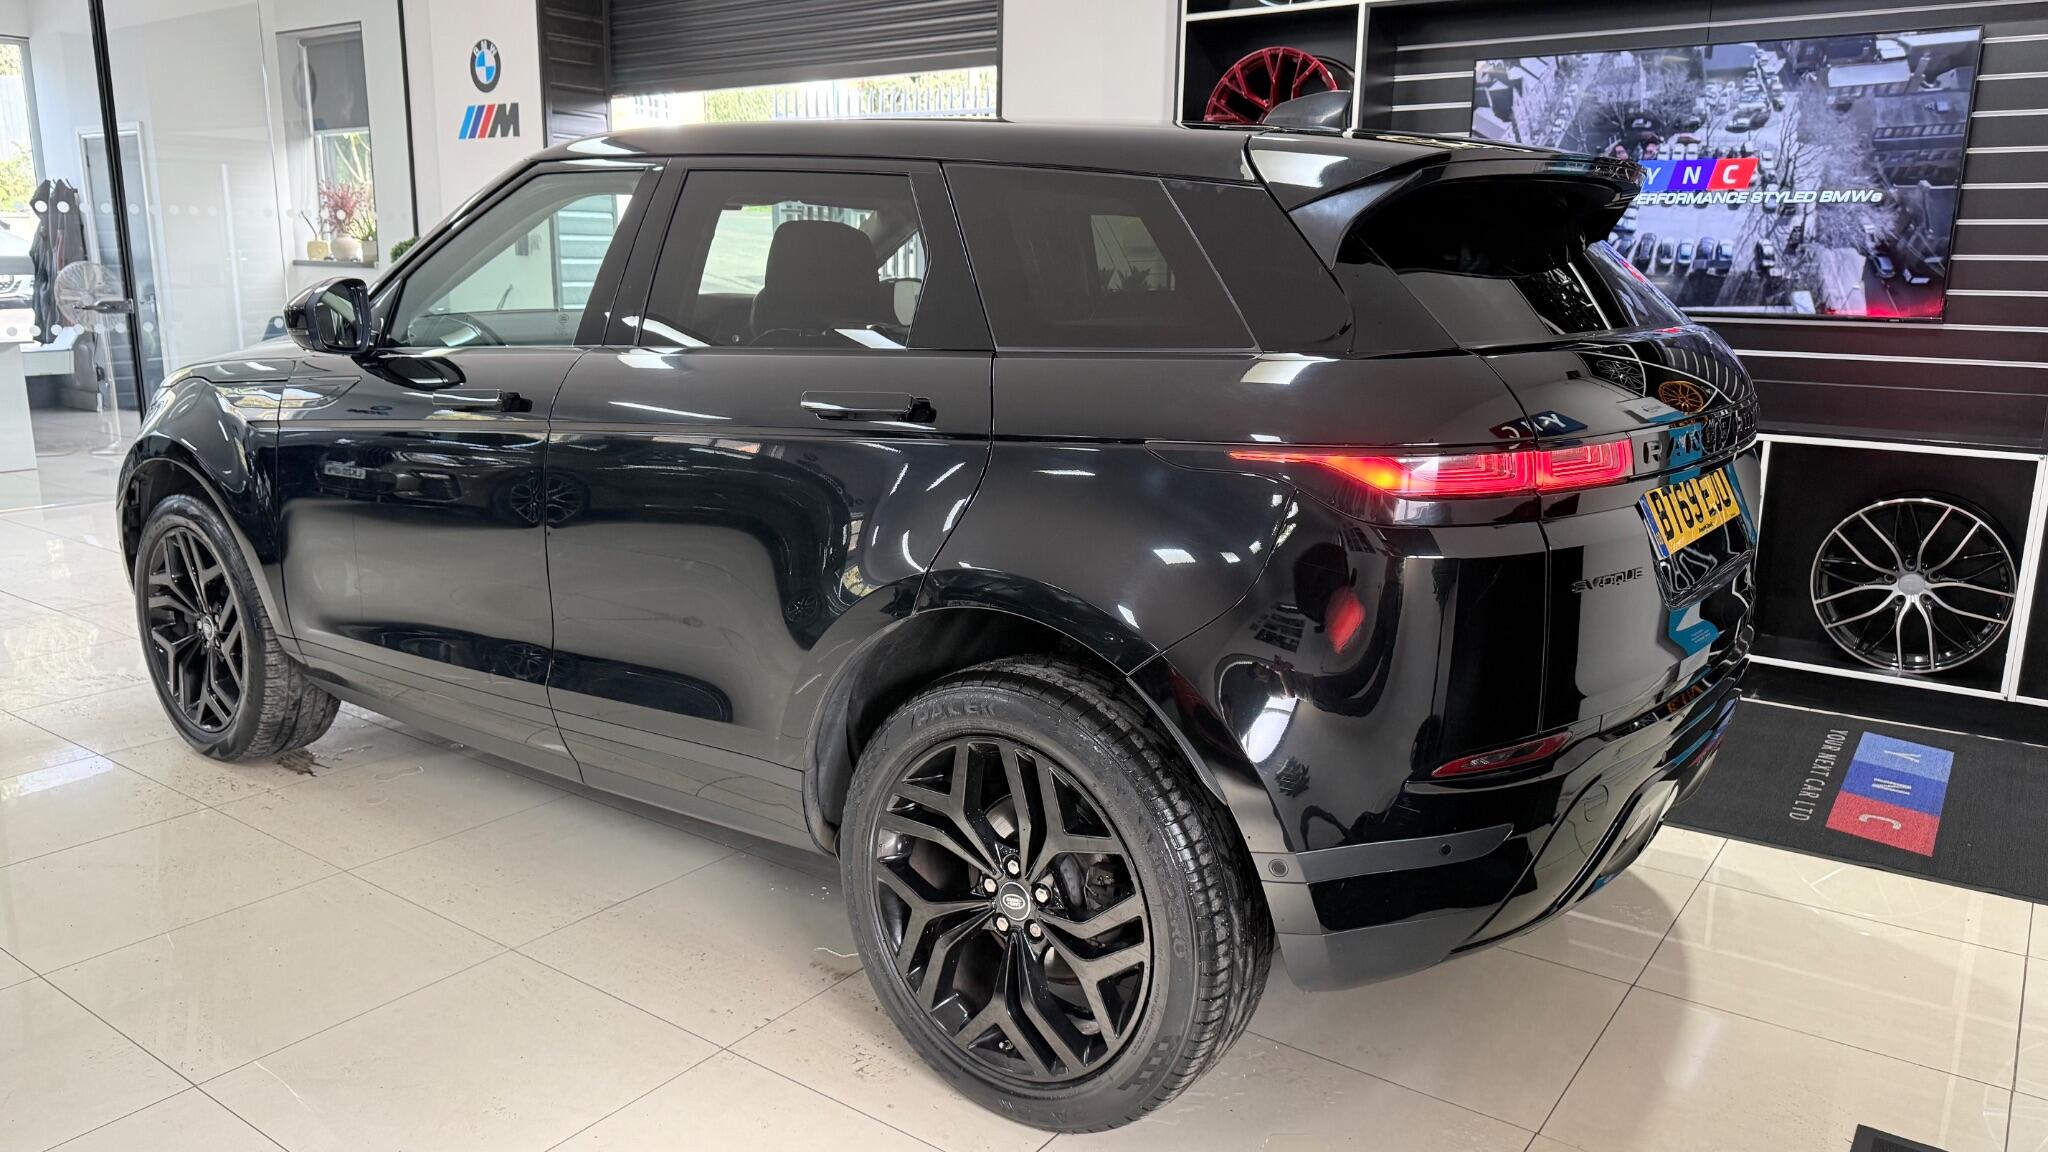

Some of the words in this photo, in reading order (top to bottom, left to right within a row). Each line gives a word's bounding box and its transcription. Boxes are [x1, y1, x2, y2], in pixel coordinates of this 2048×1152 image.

[473, 40, 498, 56] BMW
[1751, 191, 1817, 204] STYLED
[1819, 190, 1883, 203] BMWs
[1649, 480, 1704, 541] BT69
[1821, 729, 1849, 752] YOUR
[1810, 752, 1838, 777] NEXT
[1798, 778, 1826, 799] CAR
[1789, 800, 1816, 821] LTD
